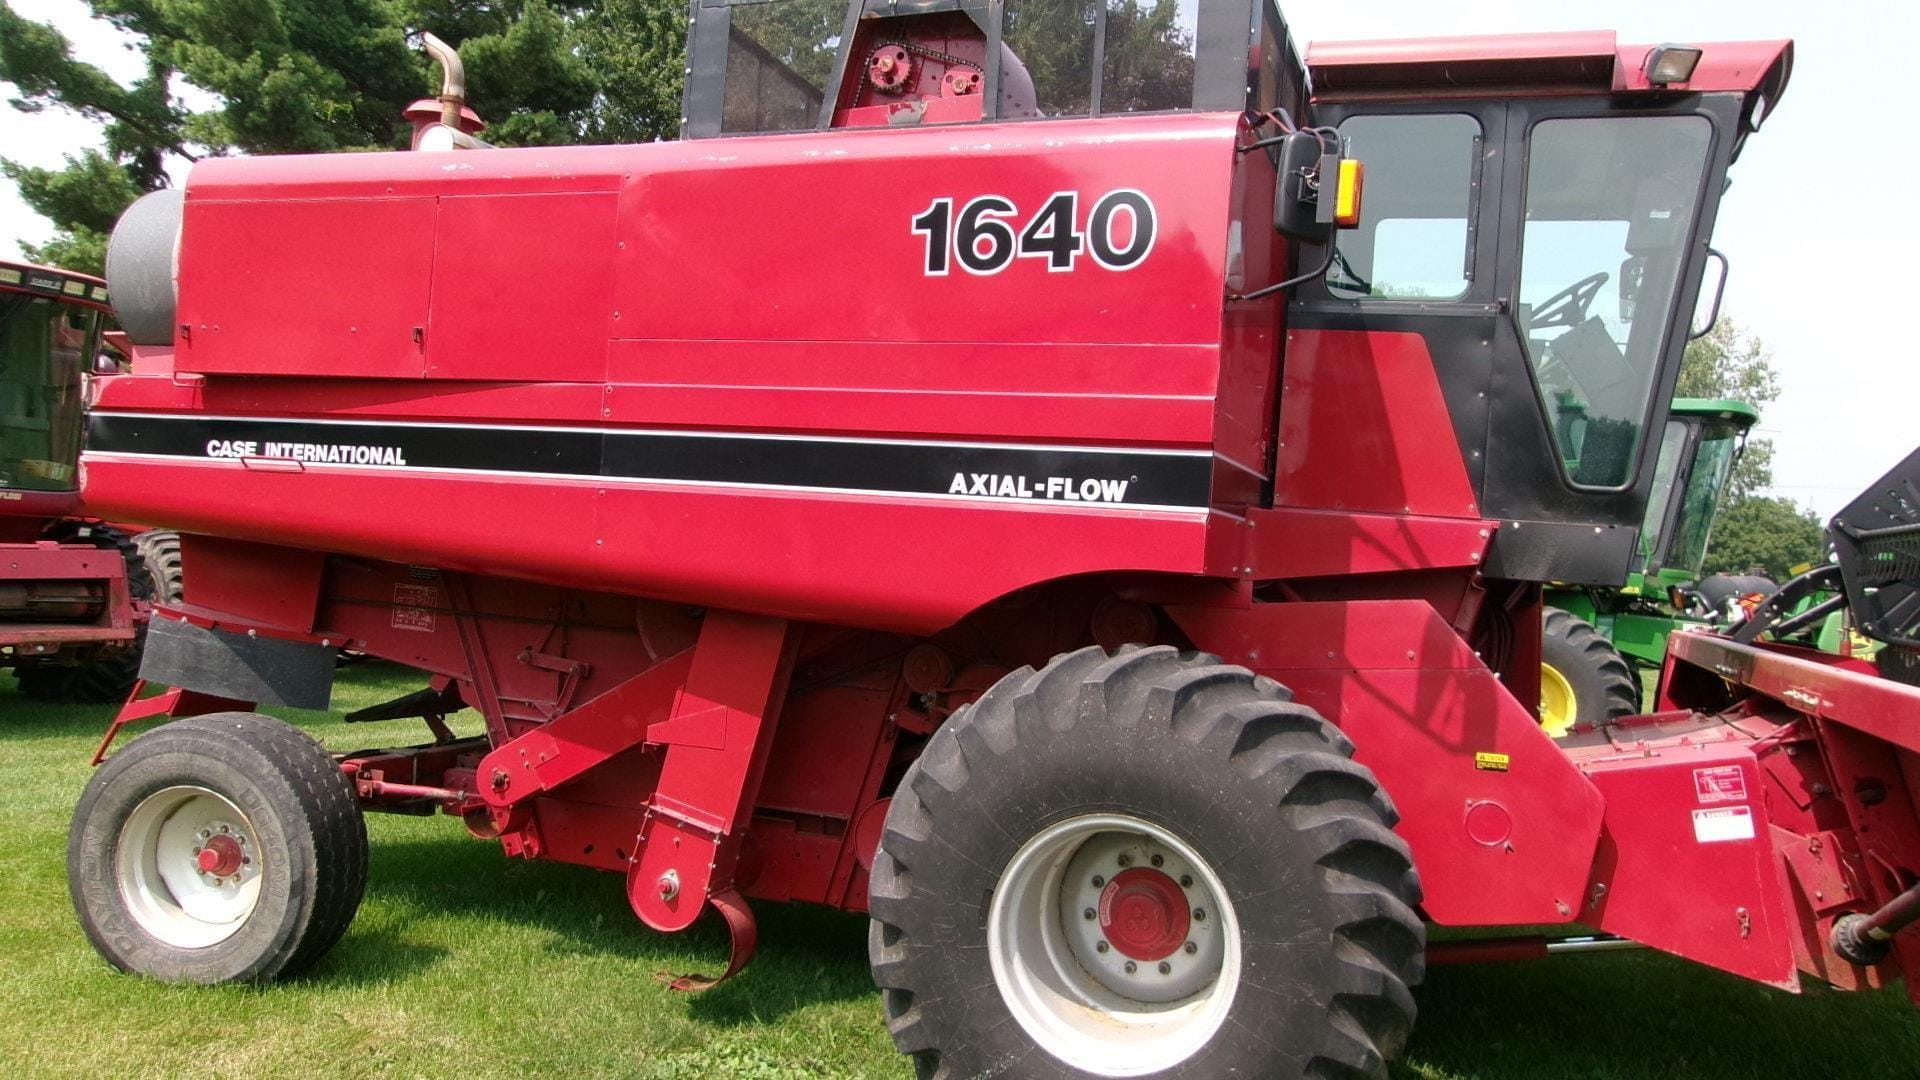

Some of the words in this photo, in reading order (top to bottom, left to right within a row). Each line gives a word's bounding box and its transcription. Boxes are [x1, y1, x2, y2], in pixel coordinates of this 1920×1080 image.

[911, 188, 1157, 276] 1640
[207, 440, 257, 458] CASE
[265, 442, 406, 466] INTERNATIONAL
[949, 472, 1128, 503] AXIAL-FLOW
